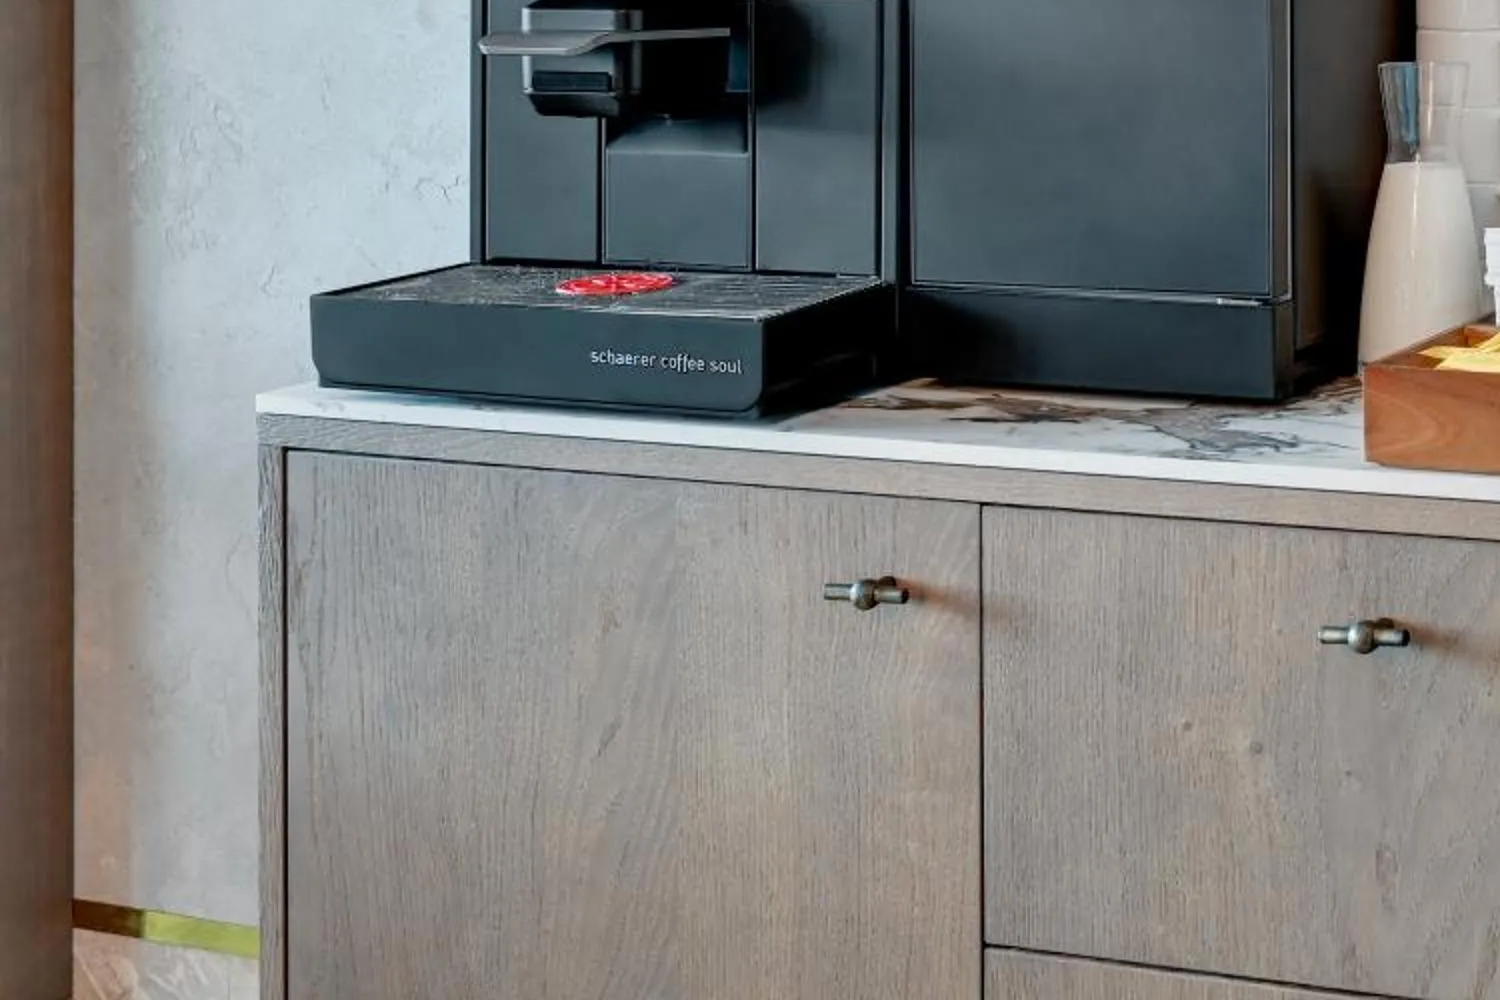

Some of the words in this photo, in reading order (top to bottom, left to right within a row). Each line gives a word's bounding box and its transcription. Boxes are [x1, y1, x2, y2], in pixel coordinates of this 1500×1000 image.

[590, 349, 657, 367] schaerer
[661, 353, 705, 373] coffee
[709, 359, 742, 374] soul
